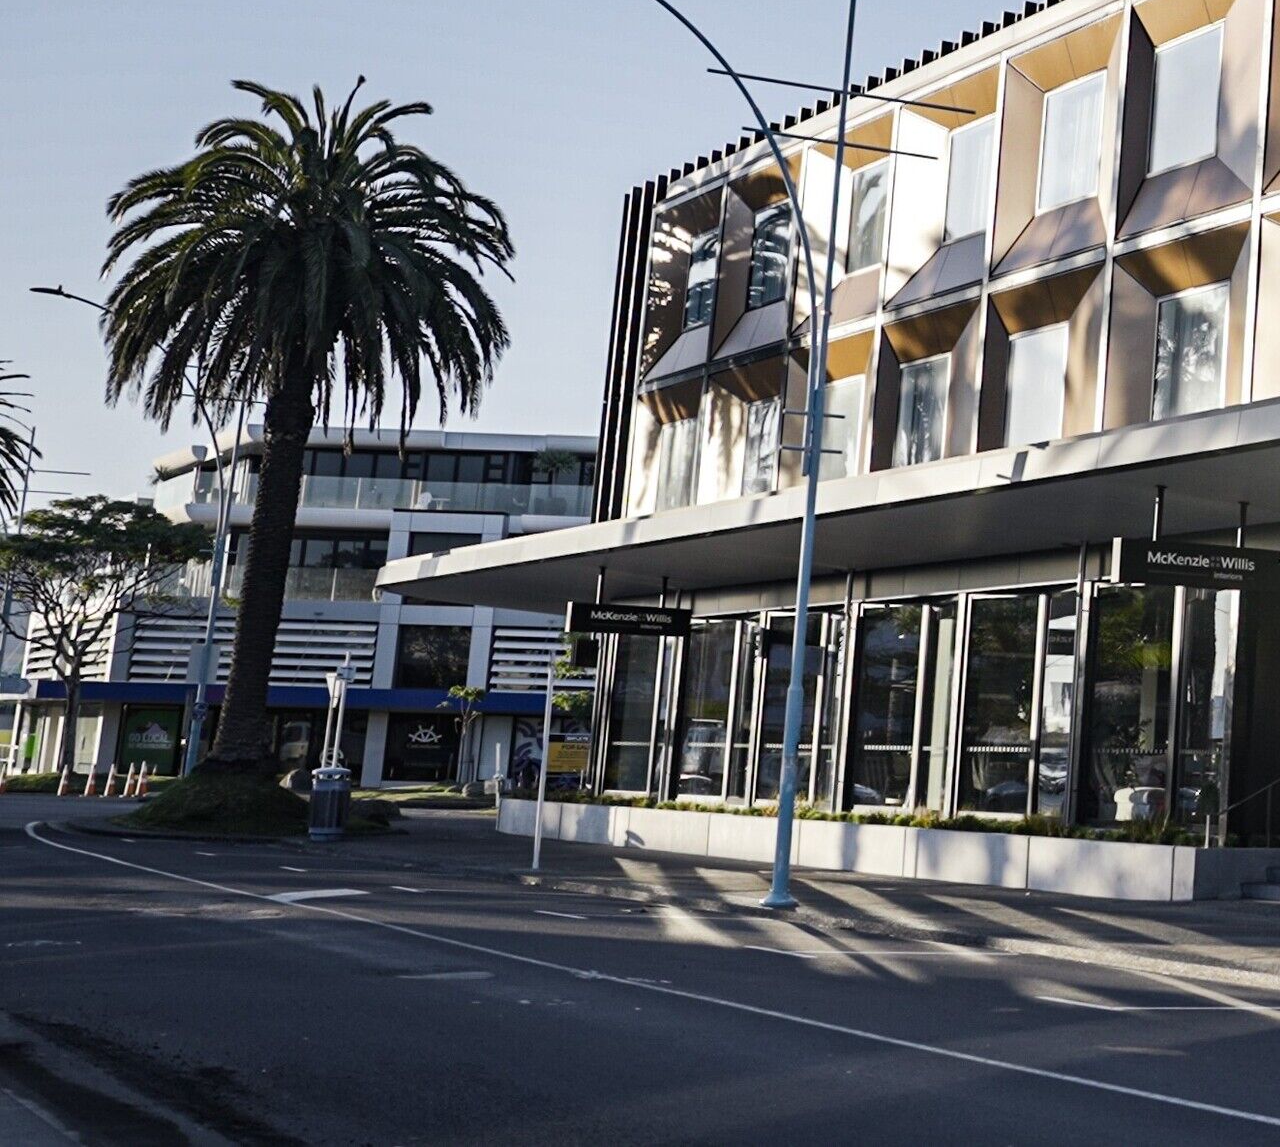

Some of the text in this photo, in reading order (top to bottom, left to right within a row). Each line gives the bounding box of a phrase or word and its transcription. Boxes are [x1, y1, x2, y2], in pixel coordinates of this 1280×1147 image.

[1147, 551, 1256, 571] McKenzie Willis
[590, 610, 673, 624] McKenzie Willis
